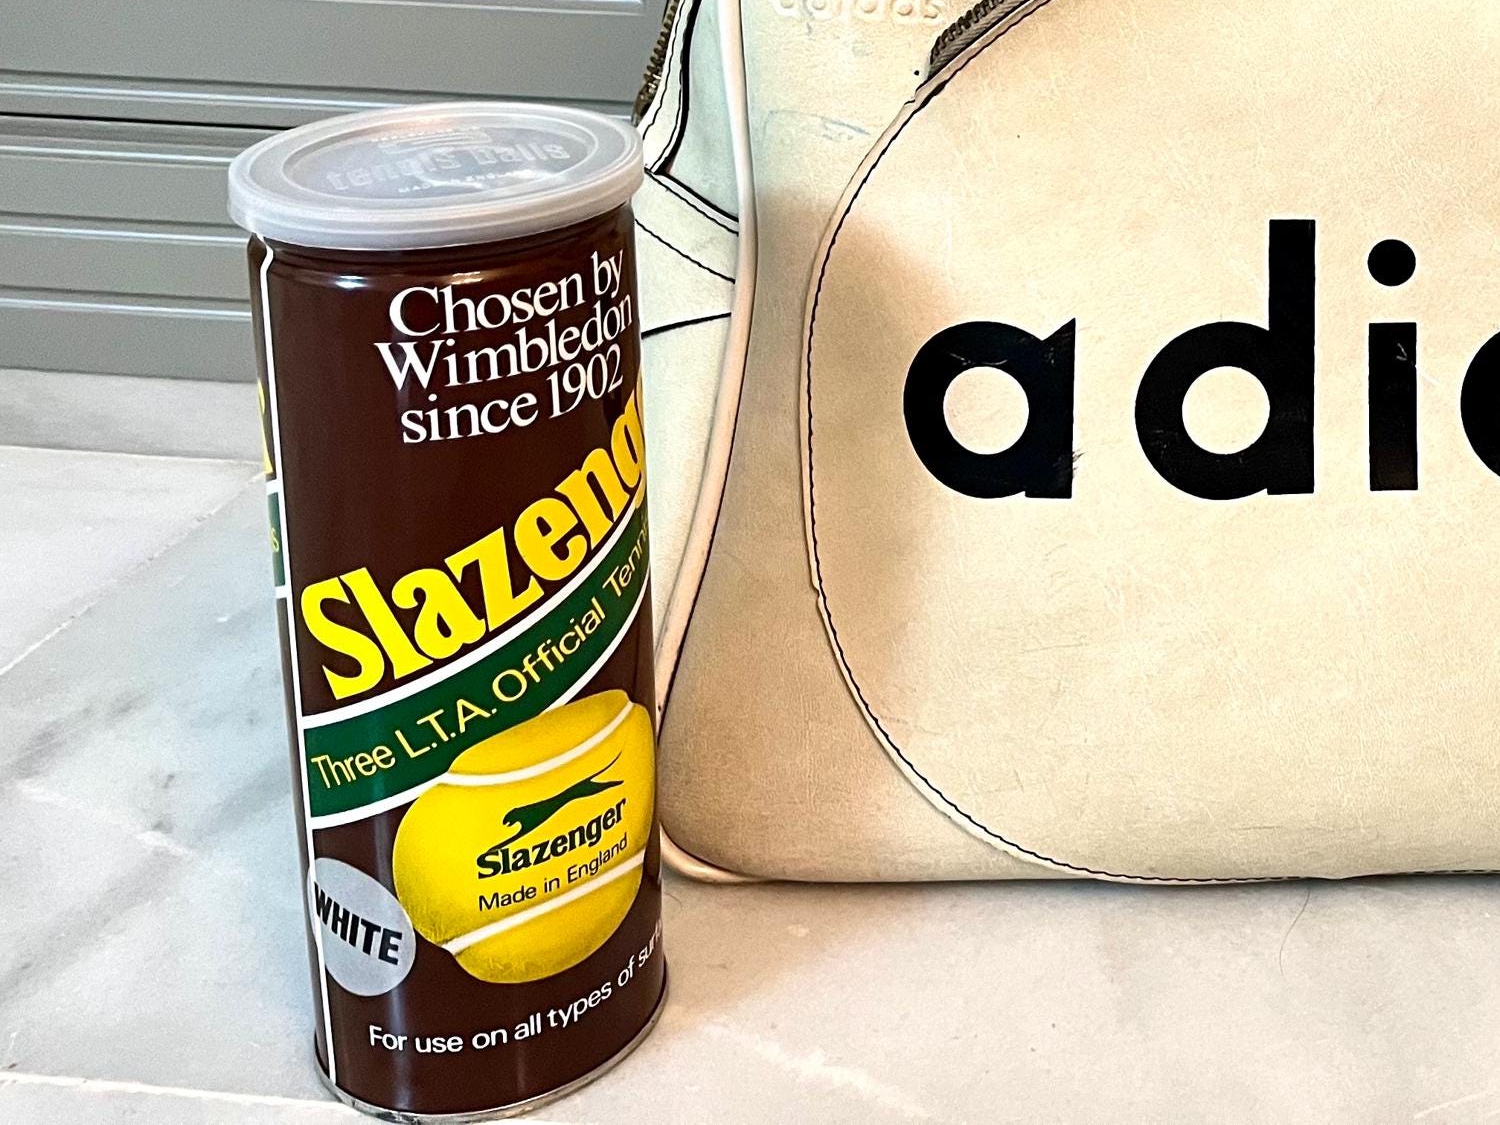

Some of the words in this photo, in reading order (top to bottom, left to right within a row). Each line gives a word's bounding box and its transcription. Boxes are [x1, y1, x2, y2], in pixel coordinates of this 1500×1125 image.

[388, 271, 583, 337] Chosen
[592, 249, 625, 299] by
[373, 293, 633, 391] Wimbledon
[401, 392, 539, 444] since
[549, 344, 625, 419] 1902
[311, 742, 396, 789] Three
[395, 698, 498, 760] L.T.A.
[491, 599, 606, 702] Official
[476, 797, 627, 880] Slazenger
[478, 882, 537, 912] Made
[543, 877, 561, 894] in
[567, 835, 628, 884] England
[312, 880, 403, 966] WHITE
[369, 1025, 408, 1052] For
[415, 1033, 464, 1054] use
[472, 1028, 508, 1050] on
[514, 1013, 542, 1041] all
[546, 982, 613, 1029] types
[617, 954, 635, 987] of
